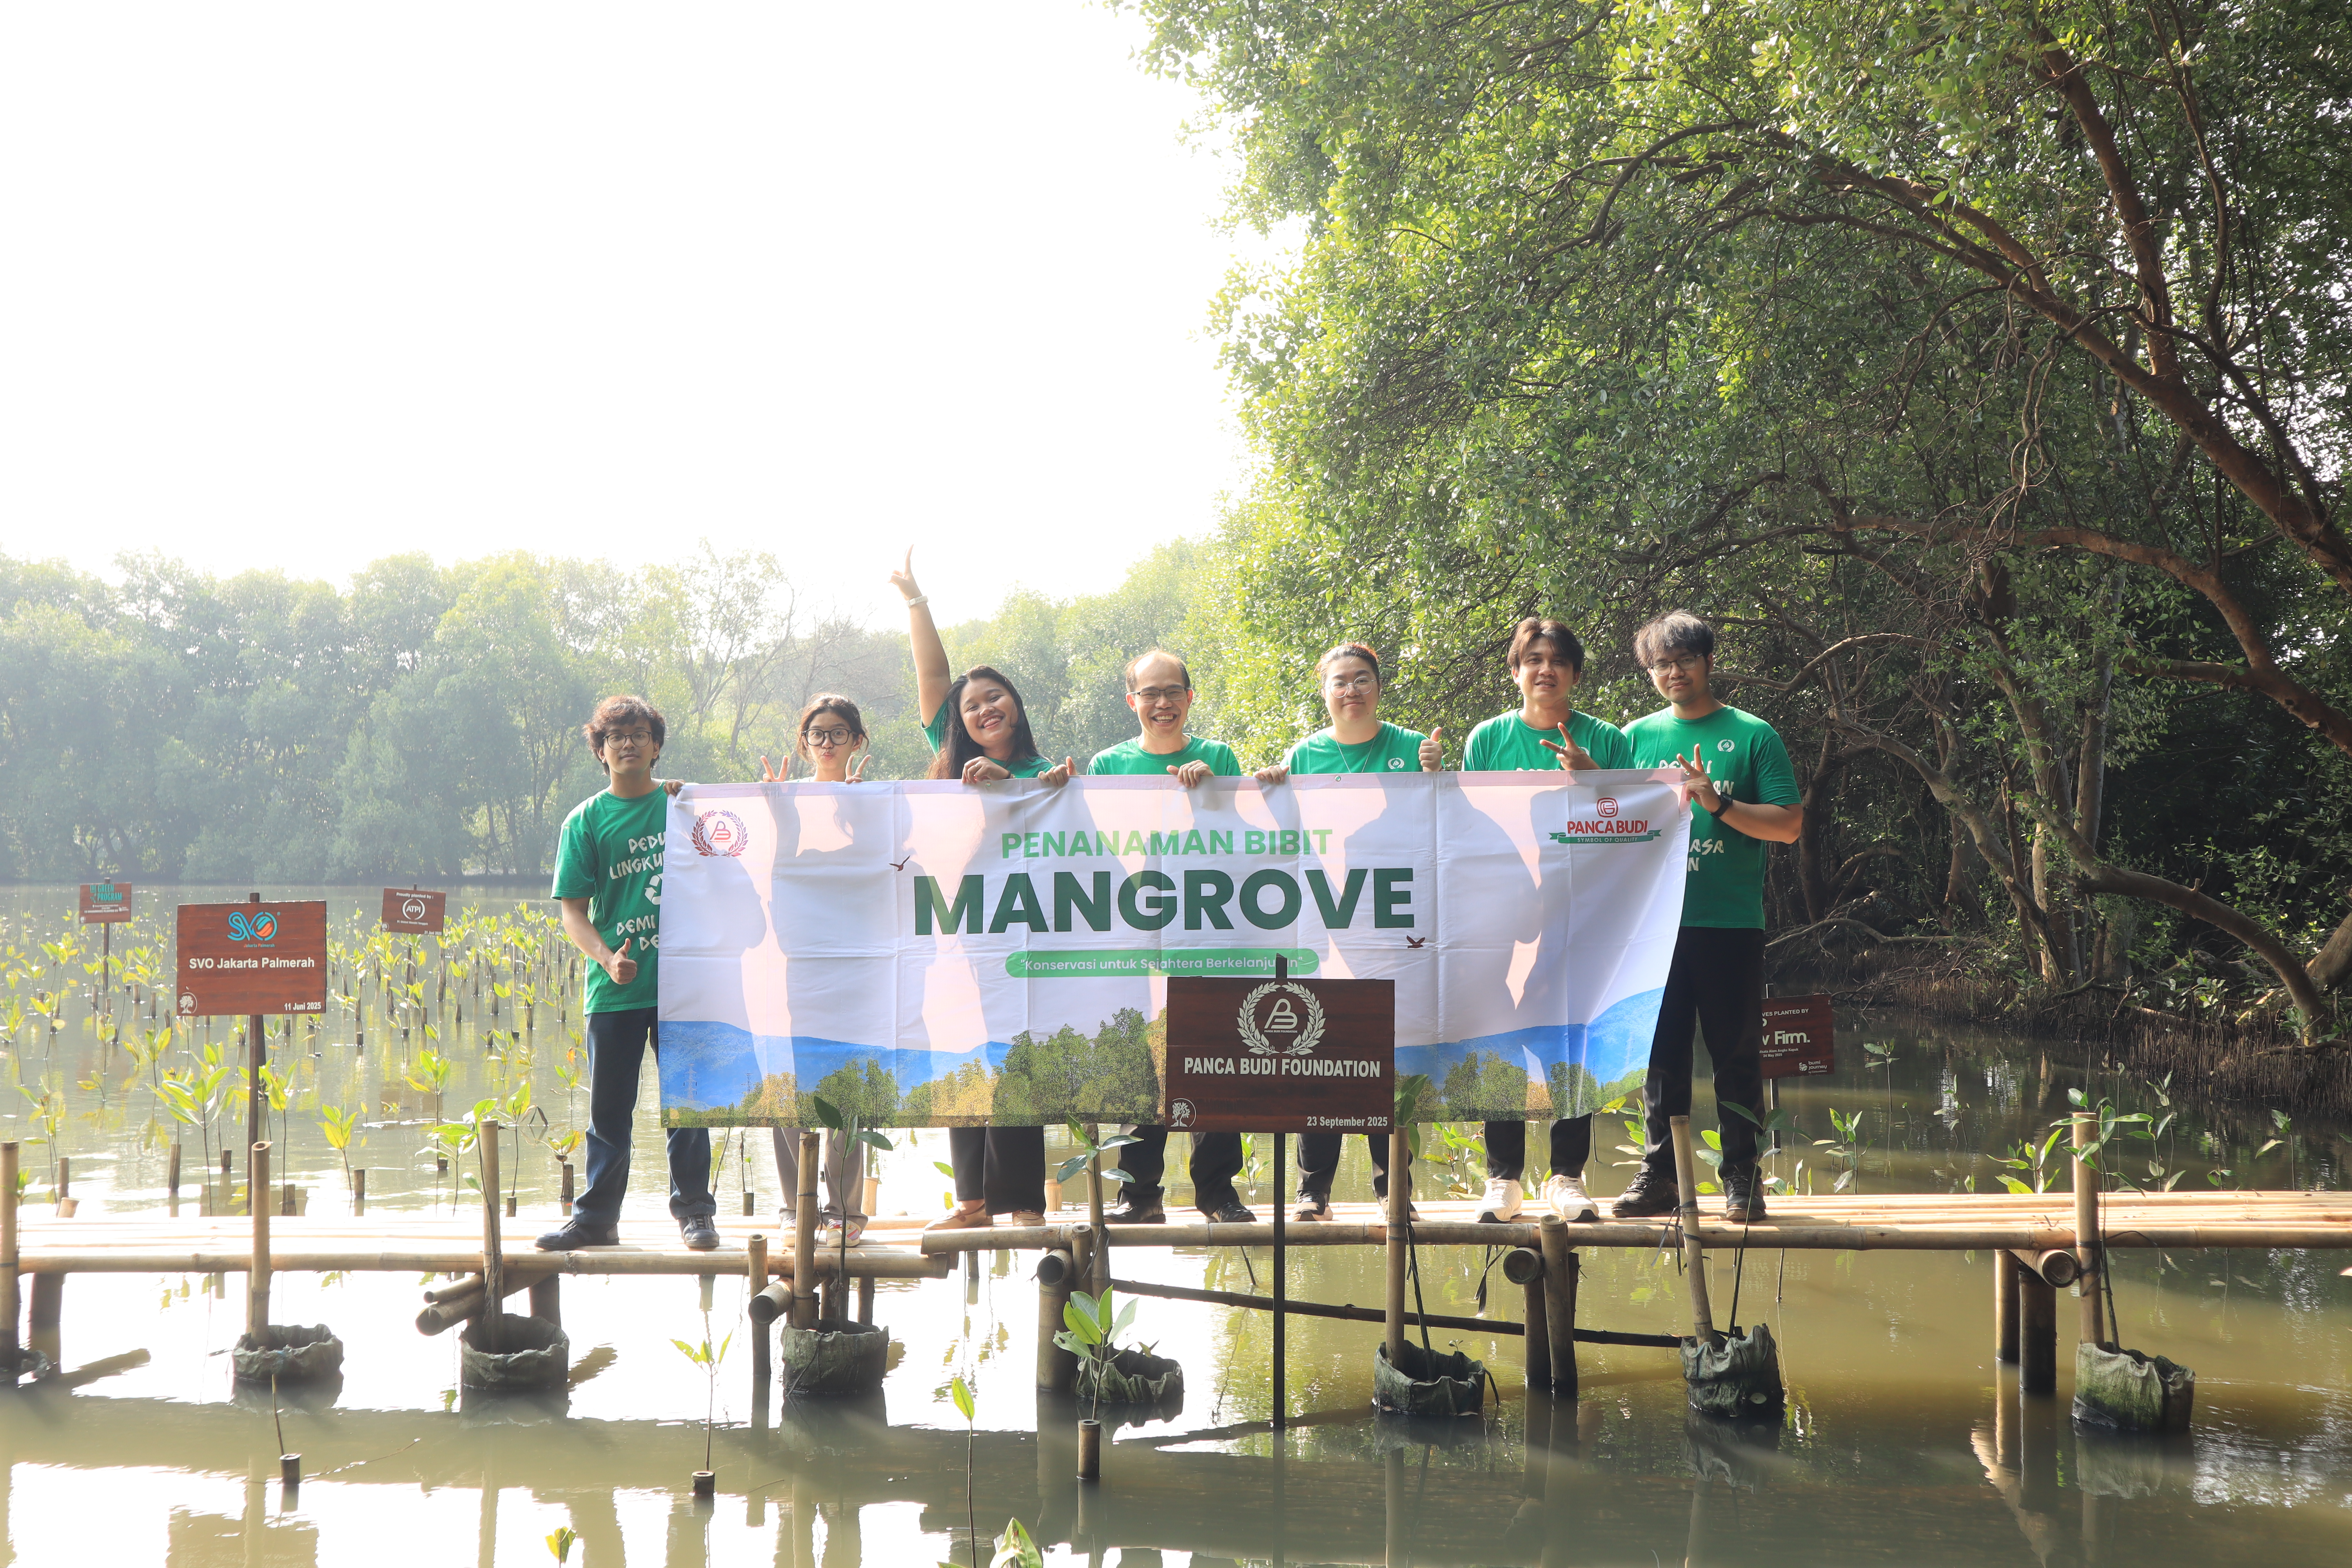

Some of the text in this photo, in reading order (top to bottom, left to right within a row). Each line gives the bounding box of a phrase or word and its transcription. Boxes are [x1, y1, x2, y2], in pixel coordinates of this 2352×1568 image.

[1567, 820, 1648, 834] PANCA BUDI
[628, 831, 666, 854] PEDU
[1002, 829, 1332, 859] PENANAMAN BIBIT
[609, 851, 665, 879] LINGKU
[98, 884, 114, 893] GREEN
[97, 893, 122, 901] PROGRAM
[913, 867, 1415, 935] MANGROVE
[406, 905, 421, 913] ATPI
[616, 914, 656, 936] DEMI
[189, 957, 315, 969] SVO Jakarta Palmerah
[1100, 958, 1137, 969] untuk
[1140, 957, 1203, 972] Sejahtera
[1206, 956, 1303, 971] Berkelanjun"
[284, 1003, 291, 1011] 11
[293, 1002, 305, 1011] Juni
[1774, 1030, 1811, 1045] Firm.
[1184, 1057, 1381, 1078] PANCA BUDI FOUNDATION
[1307, 1116, 1388, 1129] 23 September 2025
